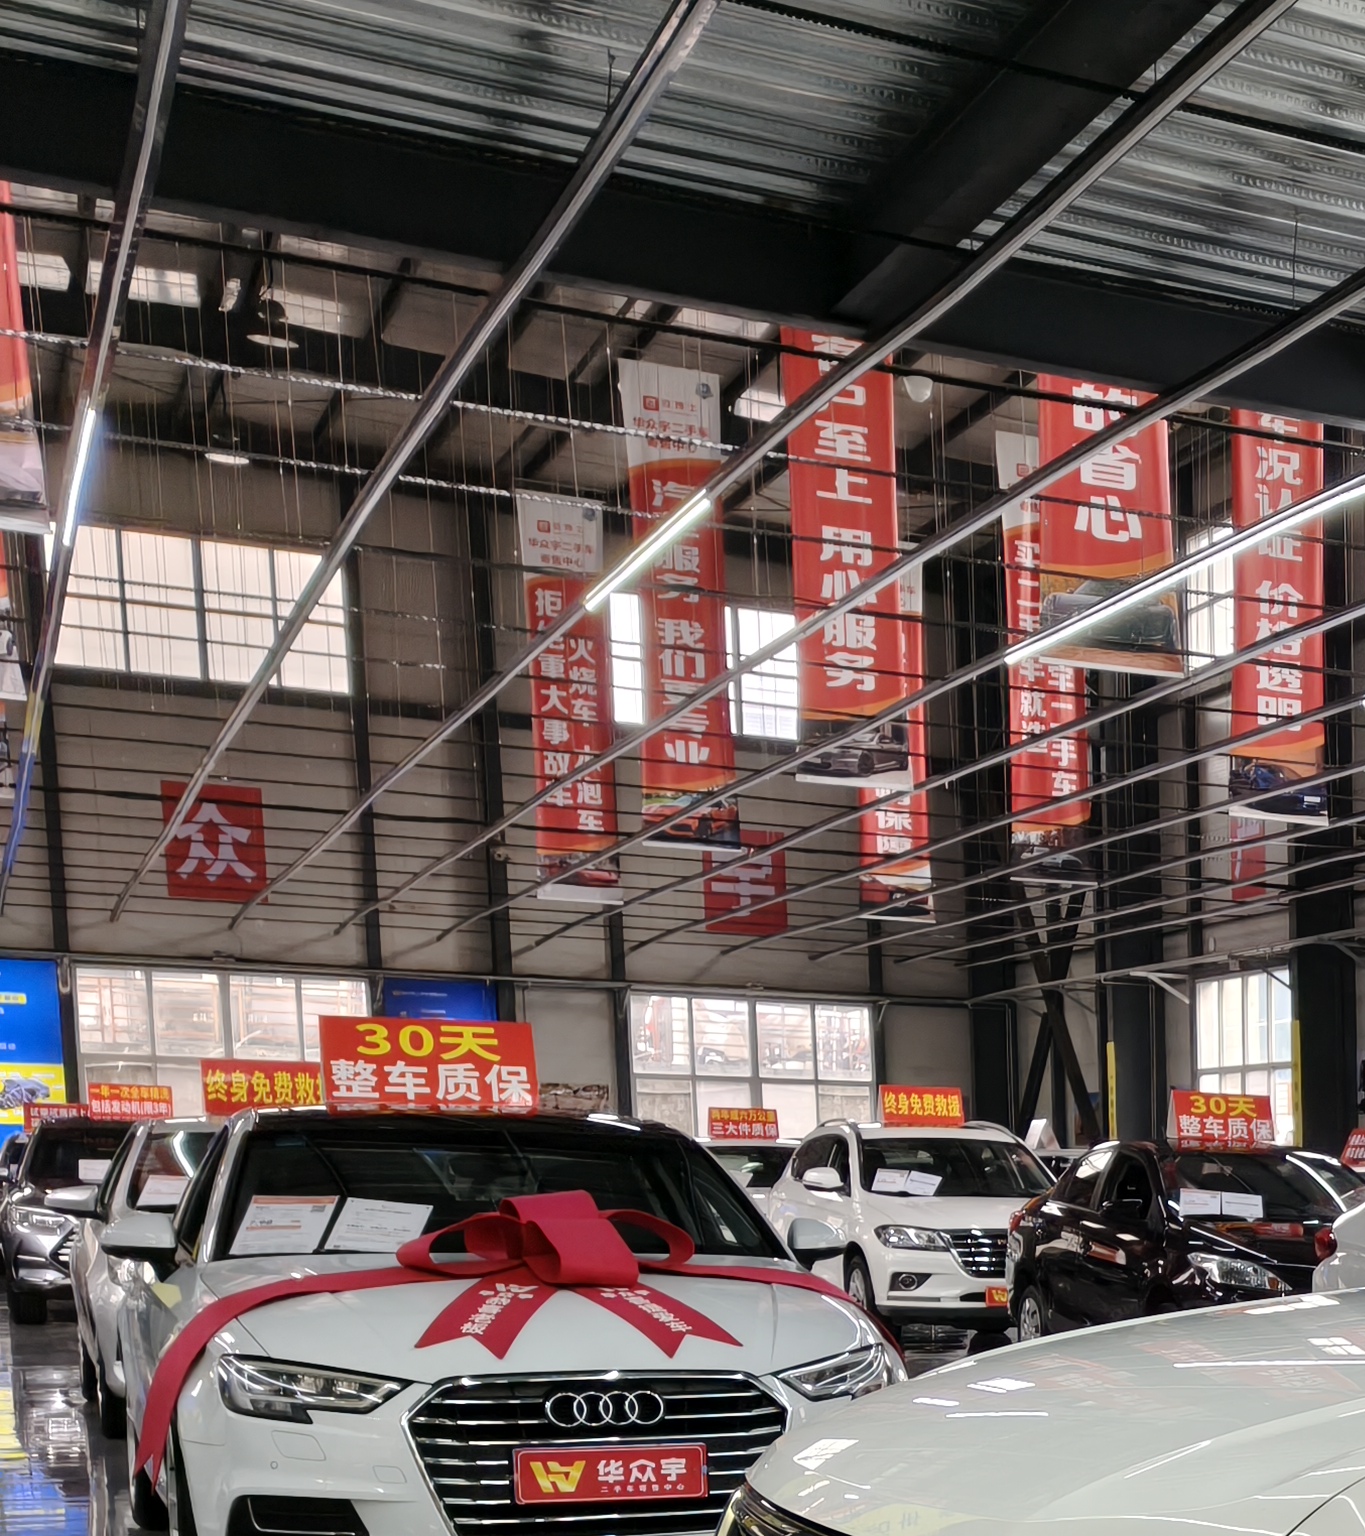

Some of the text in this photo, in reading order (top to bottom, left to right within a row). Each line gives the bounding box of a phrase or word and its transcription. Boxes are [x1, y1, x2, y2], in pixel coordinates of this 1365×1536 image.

[652, 479, 700, 603] 汽服务
[820, 525, 878, 691] 用心服务
[1255, 580, 1304, 732] 价格透明
[175, 802, 257, 884] 众
[355, 1023, 502, 1061] 30天
[330, 1059, 534, 1107] 整车质保
[884, 1091, 961, 1117] 终身免费救援
[1189, 1095, 1257, 1118] 30天
[711, 1121, 778, 1137] 三大件质保
[1178, 1114, 1272, 1140] 整车质保
[596, 1457, 687, 1484] 华众宇
